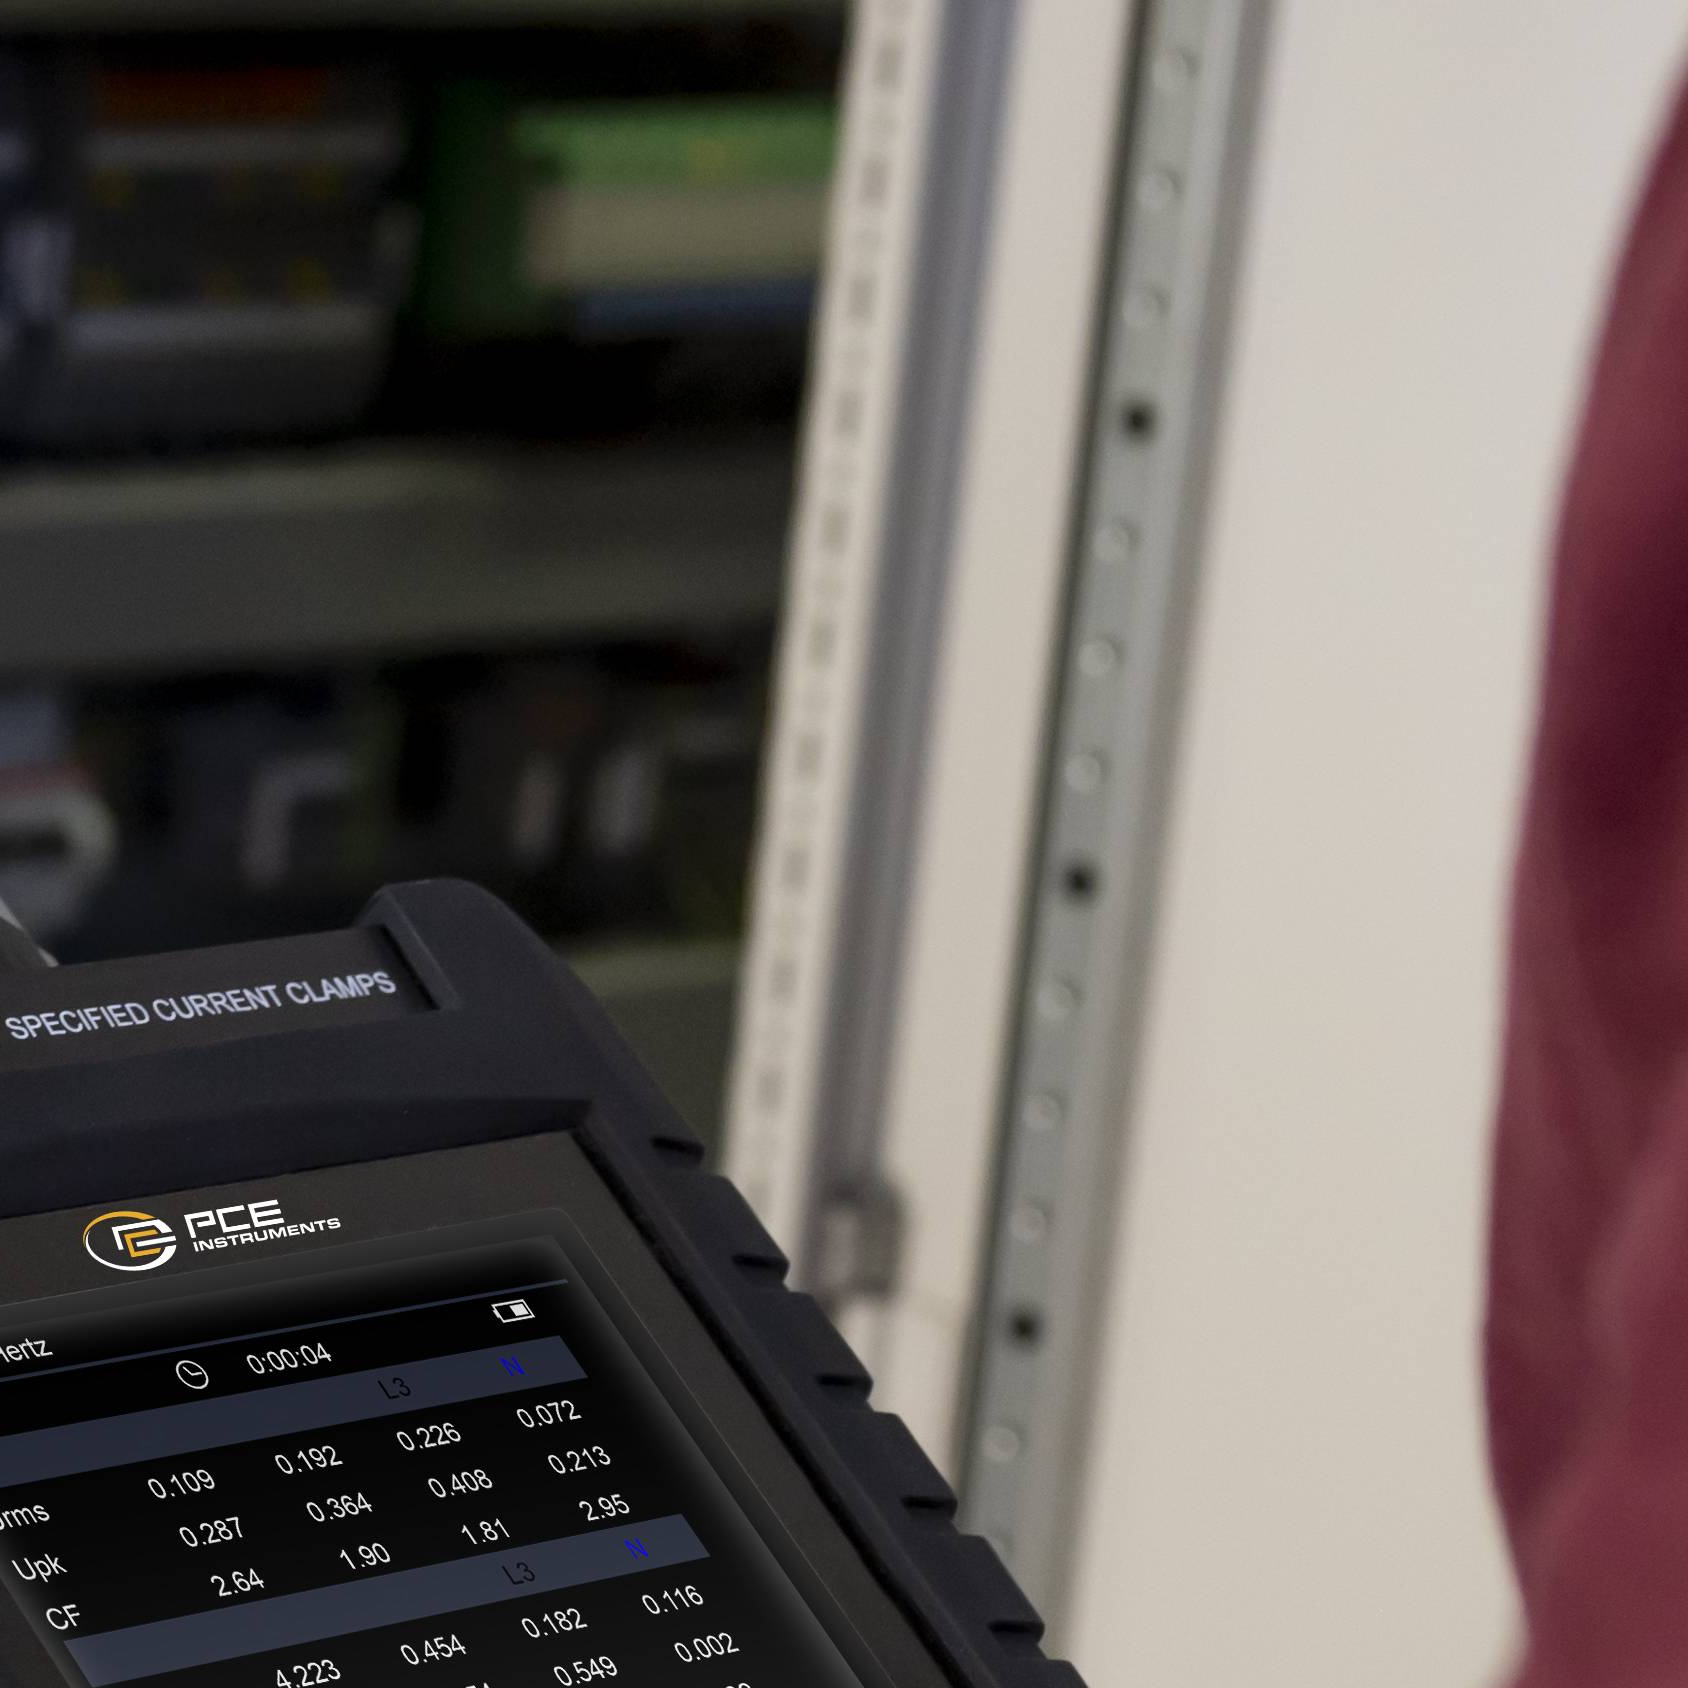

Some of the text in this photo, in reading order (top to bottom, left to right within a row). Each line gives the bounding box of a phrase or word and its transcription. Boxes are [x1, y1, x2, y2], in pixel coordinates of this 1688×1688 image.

[5, 1002, 149, 1040] SPECIFIED
[152, 984, 283, 1021] CURRENT
[285, 971, 396, 1005] CLAMPS
[183, 1199, 285, 1239] PCE
[192, 1217, 341, 1252] INSTRUMENTS
[246, 1343, 332, 1375] 0:00:04
[377, 1355, 525, 1400] L3 N
[147, 1469, 215, 1499] 0.109
[275, 1445, 343, 1475] 0.192
[396, 1422, 461, 1451] 0.226
[516, 1400, 582, 1429] 0.072
[12, 1445, 611, 1582] Upk 0.287 0.364 0.408 0.213
[45, 1494, 631, 1630] CF 2.64 1.90 1.81 2.95
[501, 1537, 649, 1585] L3 N
[400, 1634, 466, 1666] 0.454
[521, 1608, 588, 1639] 0.182
[641, 1585, 704, 1615] 0.116
[553, 1655, 617, 1687] 0.549
[673, 1632, 739, 1663] 0.002
